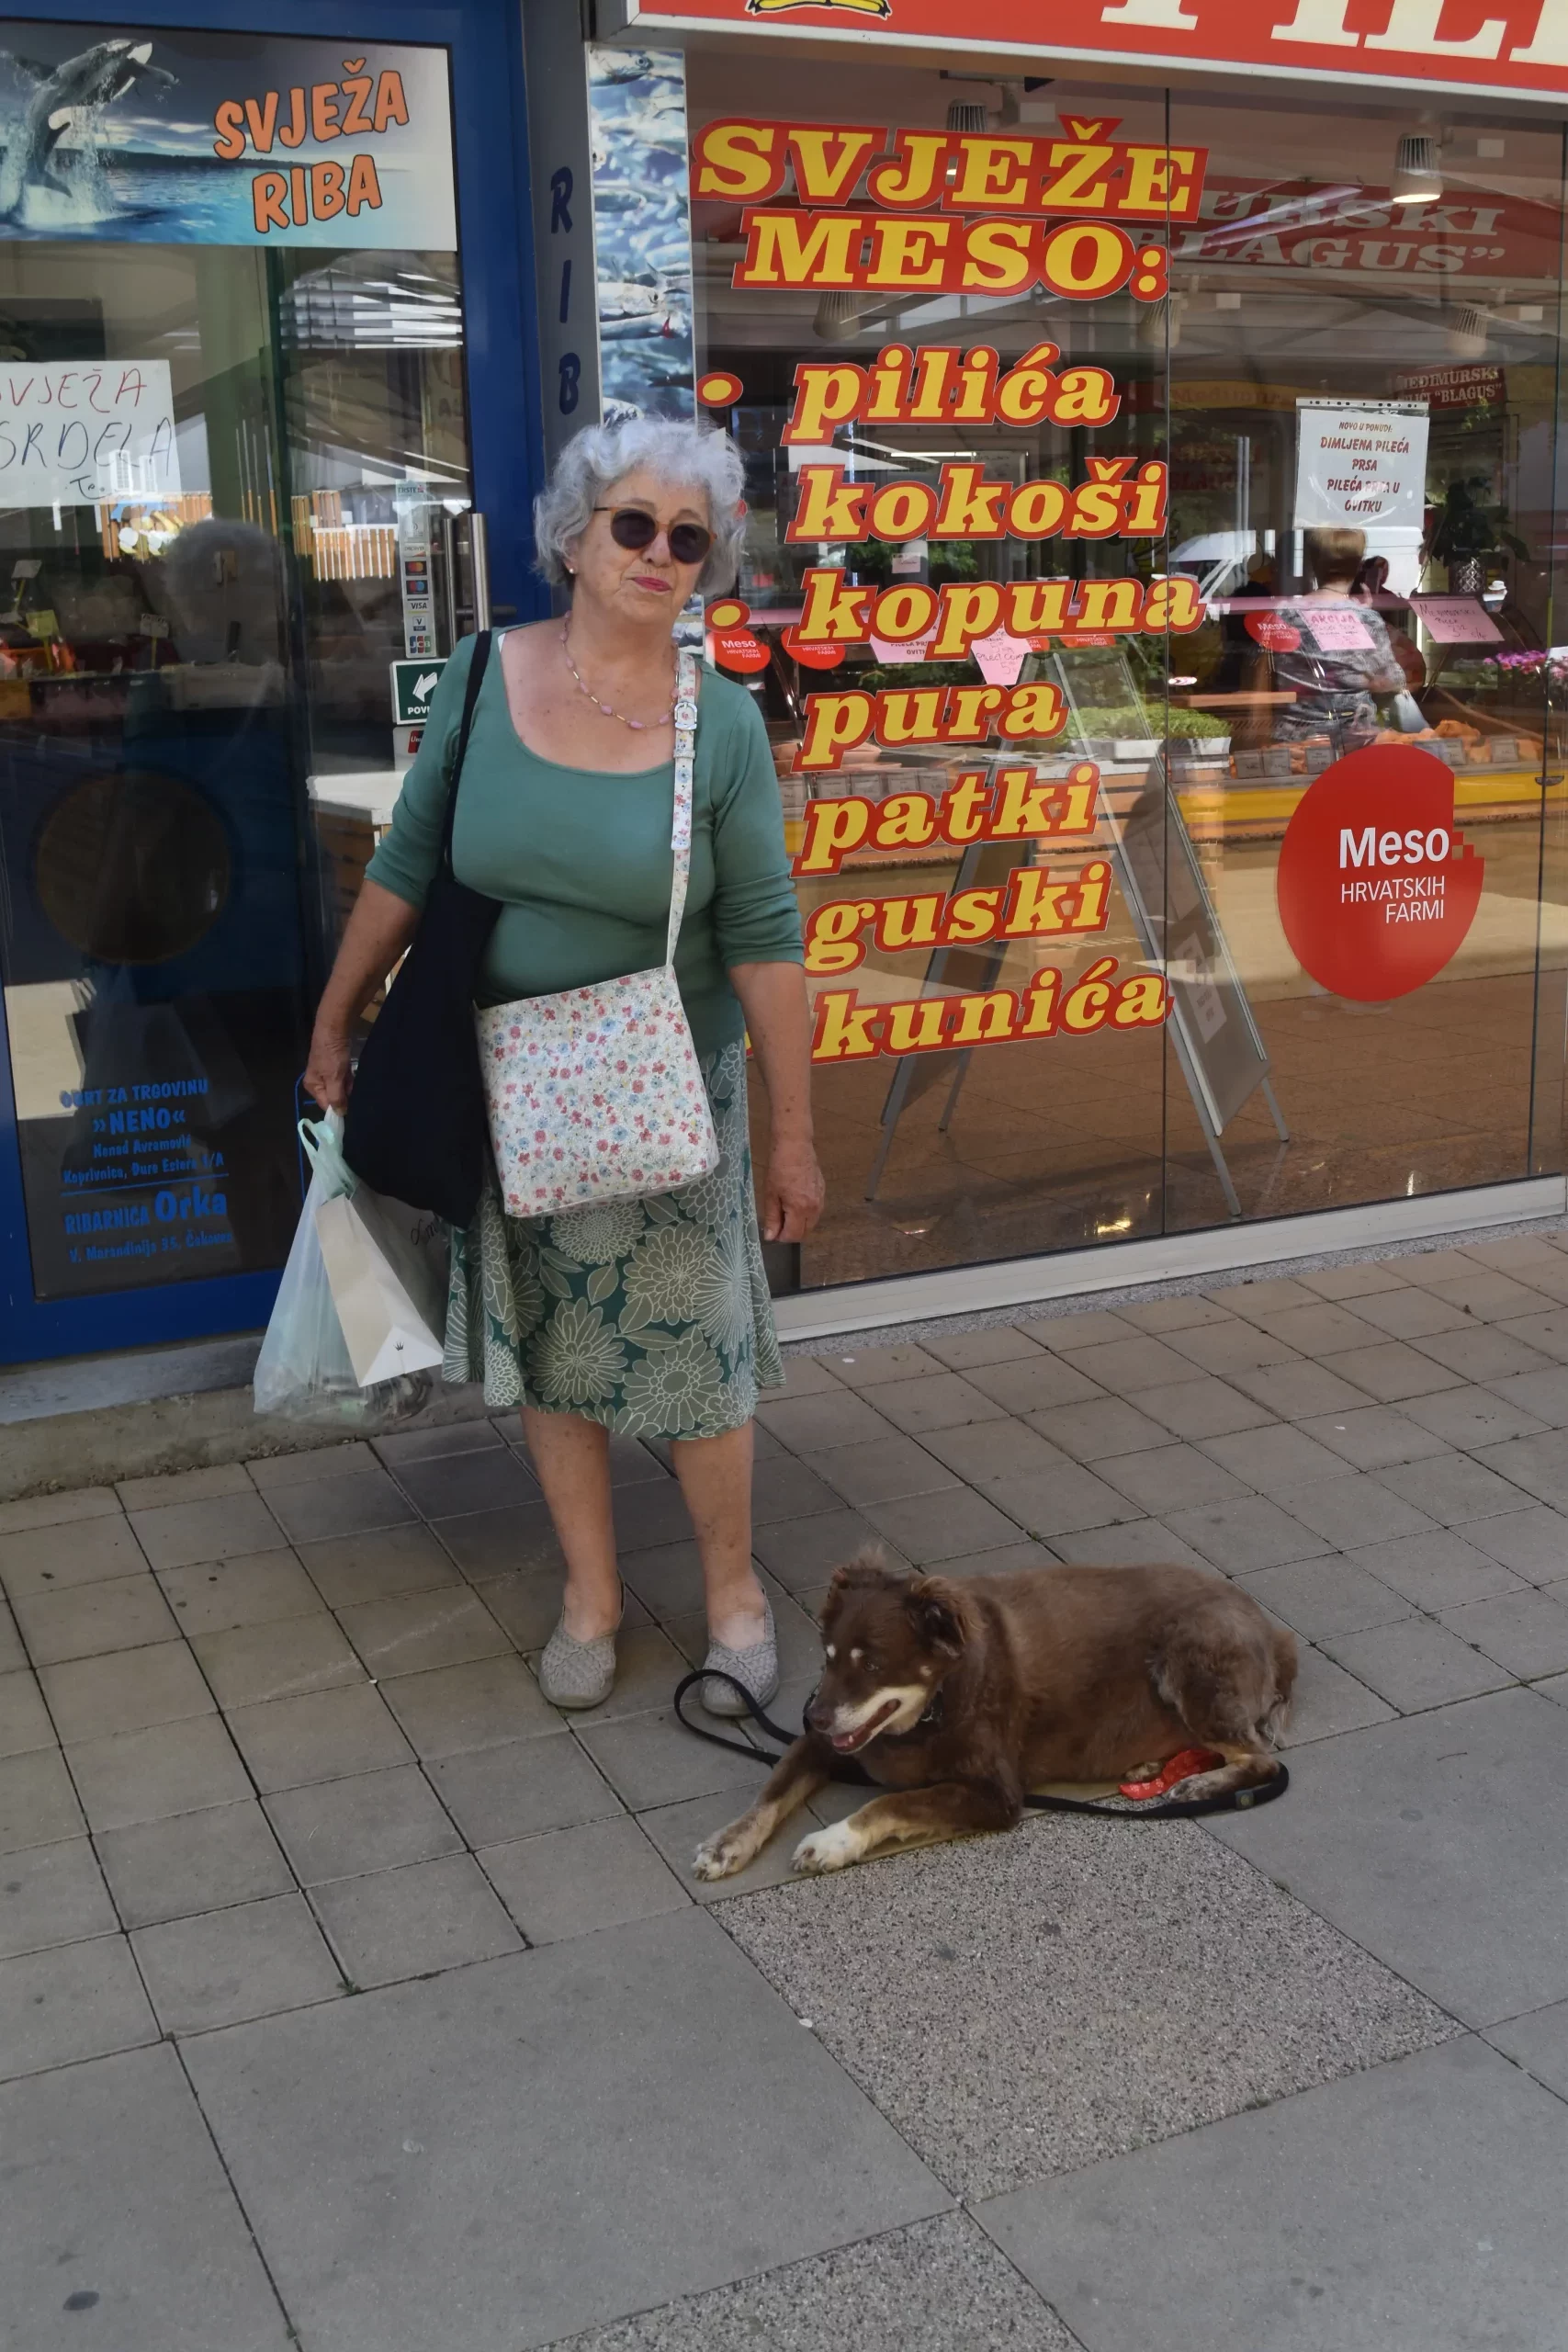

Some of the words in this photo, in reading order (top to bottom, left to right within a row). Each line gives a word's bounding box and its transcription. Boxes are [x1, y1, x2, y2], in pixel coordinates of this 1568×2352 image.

[213, 58, 410, 160] SVJEŽA
[693, 116, 1205, 220] SVJEŽE
[252, 154, 383, 233] RIBA
[734, 209, 1172, 300] MESO:
[0, 368, 147, 413] VJEŽA
[783, 345, 1119, 446] pilića
[1320, 436, 1372, 451] DIMLJENA
[1375, 436, 1409, 454] PILEĆA
[1338, 421, 1358, 431] NOVO
[1359, 423, 1365, 431] U
[1365, 423, 1393, 433] PONUDI:
[1326, 475, 1362, 492] PILEĆA
[1393, 482, 1400, 493] U
[1351, 458, 1378, 471] PRSA
[786, 458, 1168, 543] kokoši
[1344, 499, 1382, 513] OVITKU
[411, 602, 427, 610] VISA
[790, 569, 1203, 660] kopuna
[721, 639, 757, 649] Meso
[407, 706, 431, 715] POV
[793, 683, 1069, 772] pura
[792, 763, 1100, 877] patki
[1338, 827, 1450, 868] Meso
[1340, 876, 1446, 904] HRVATSKIH
[1384, 899, 1445, 923] FARMI
[806, 861, 1111, 976] guski
[811, 956, 1172, 1063] kunića
[107, 1086, 128, 1104] ZA
[132, 1077, 209, 1102] TRGOVINU
[64, 1204, 151, 1236] RIBARNICA
[154, 1184, 228, 1223] Orka
